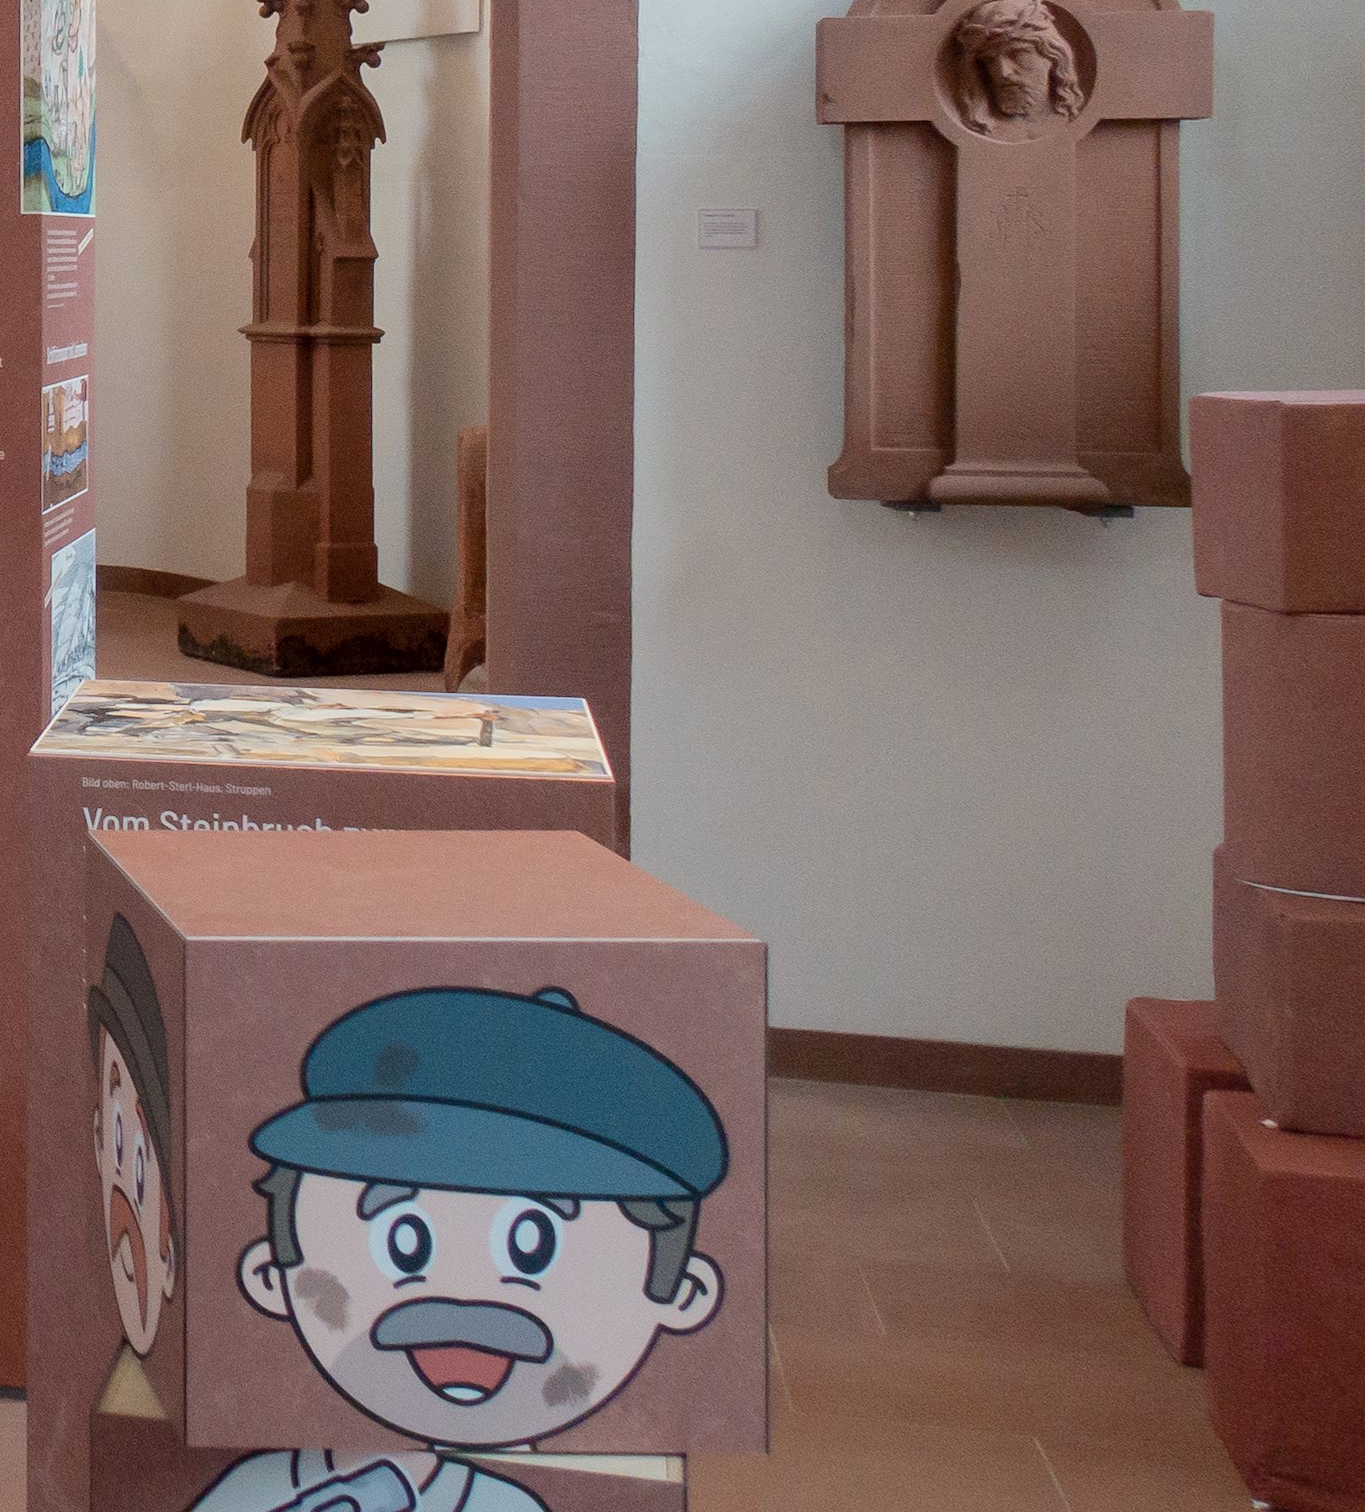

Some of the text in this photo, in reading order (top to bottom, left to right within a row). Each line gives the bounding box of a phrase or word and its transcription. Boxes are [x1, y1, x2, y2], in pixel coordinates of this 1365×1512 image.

[81, 776, 100, 787] Bild
[102, 778, 129, 788] oben:
[224, 782, 271, 796] Struppen
[82, 807, 148, 830] Vom
